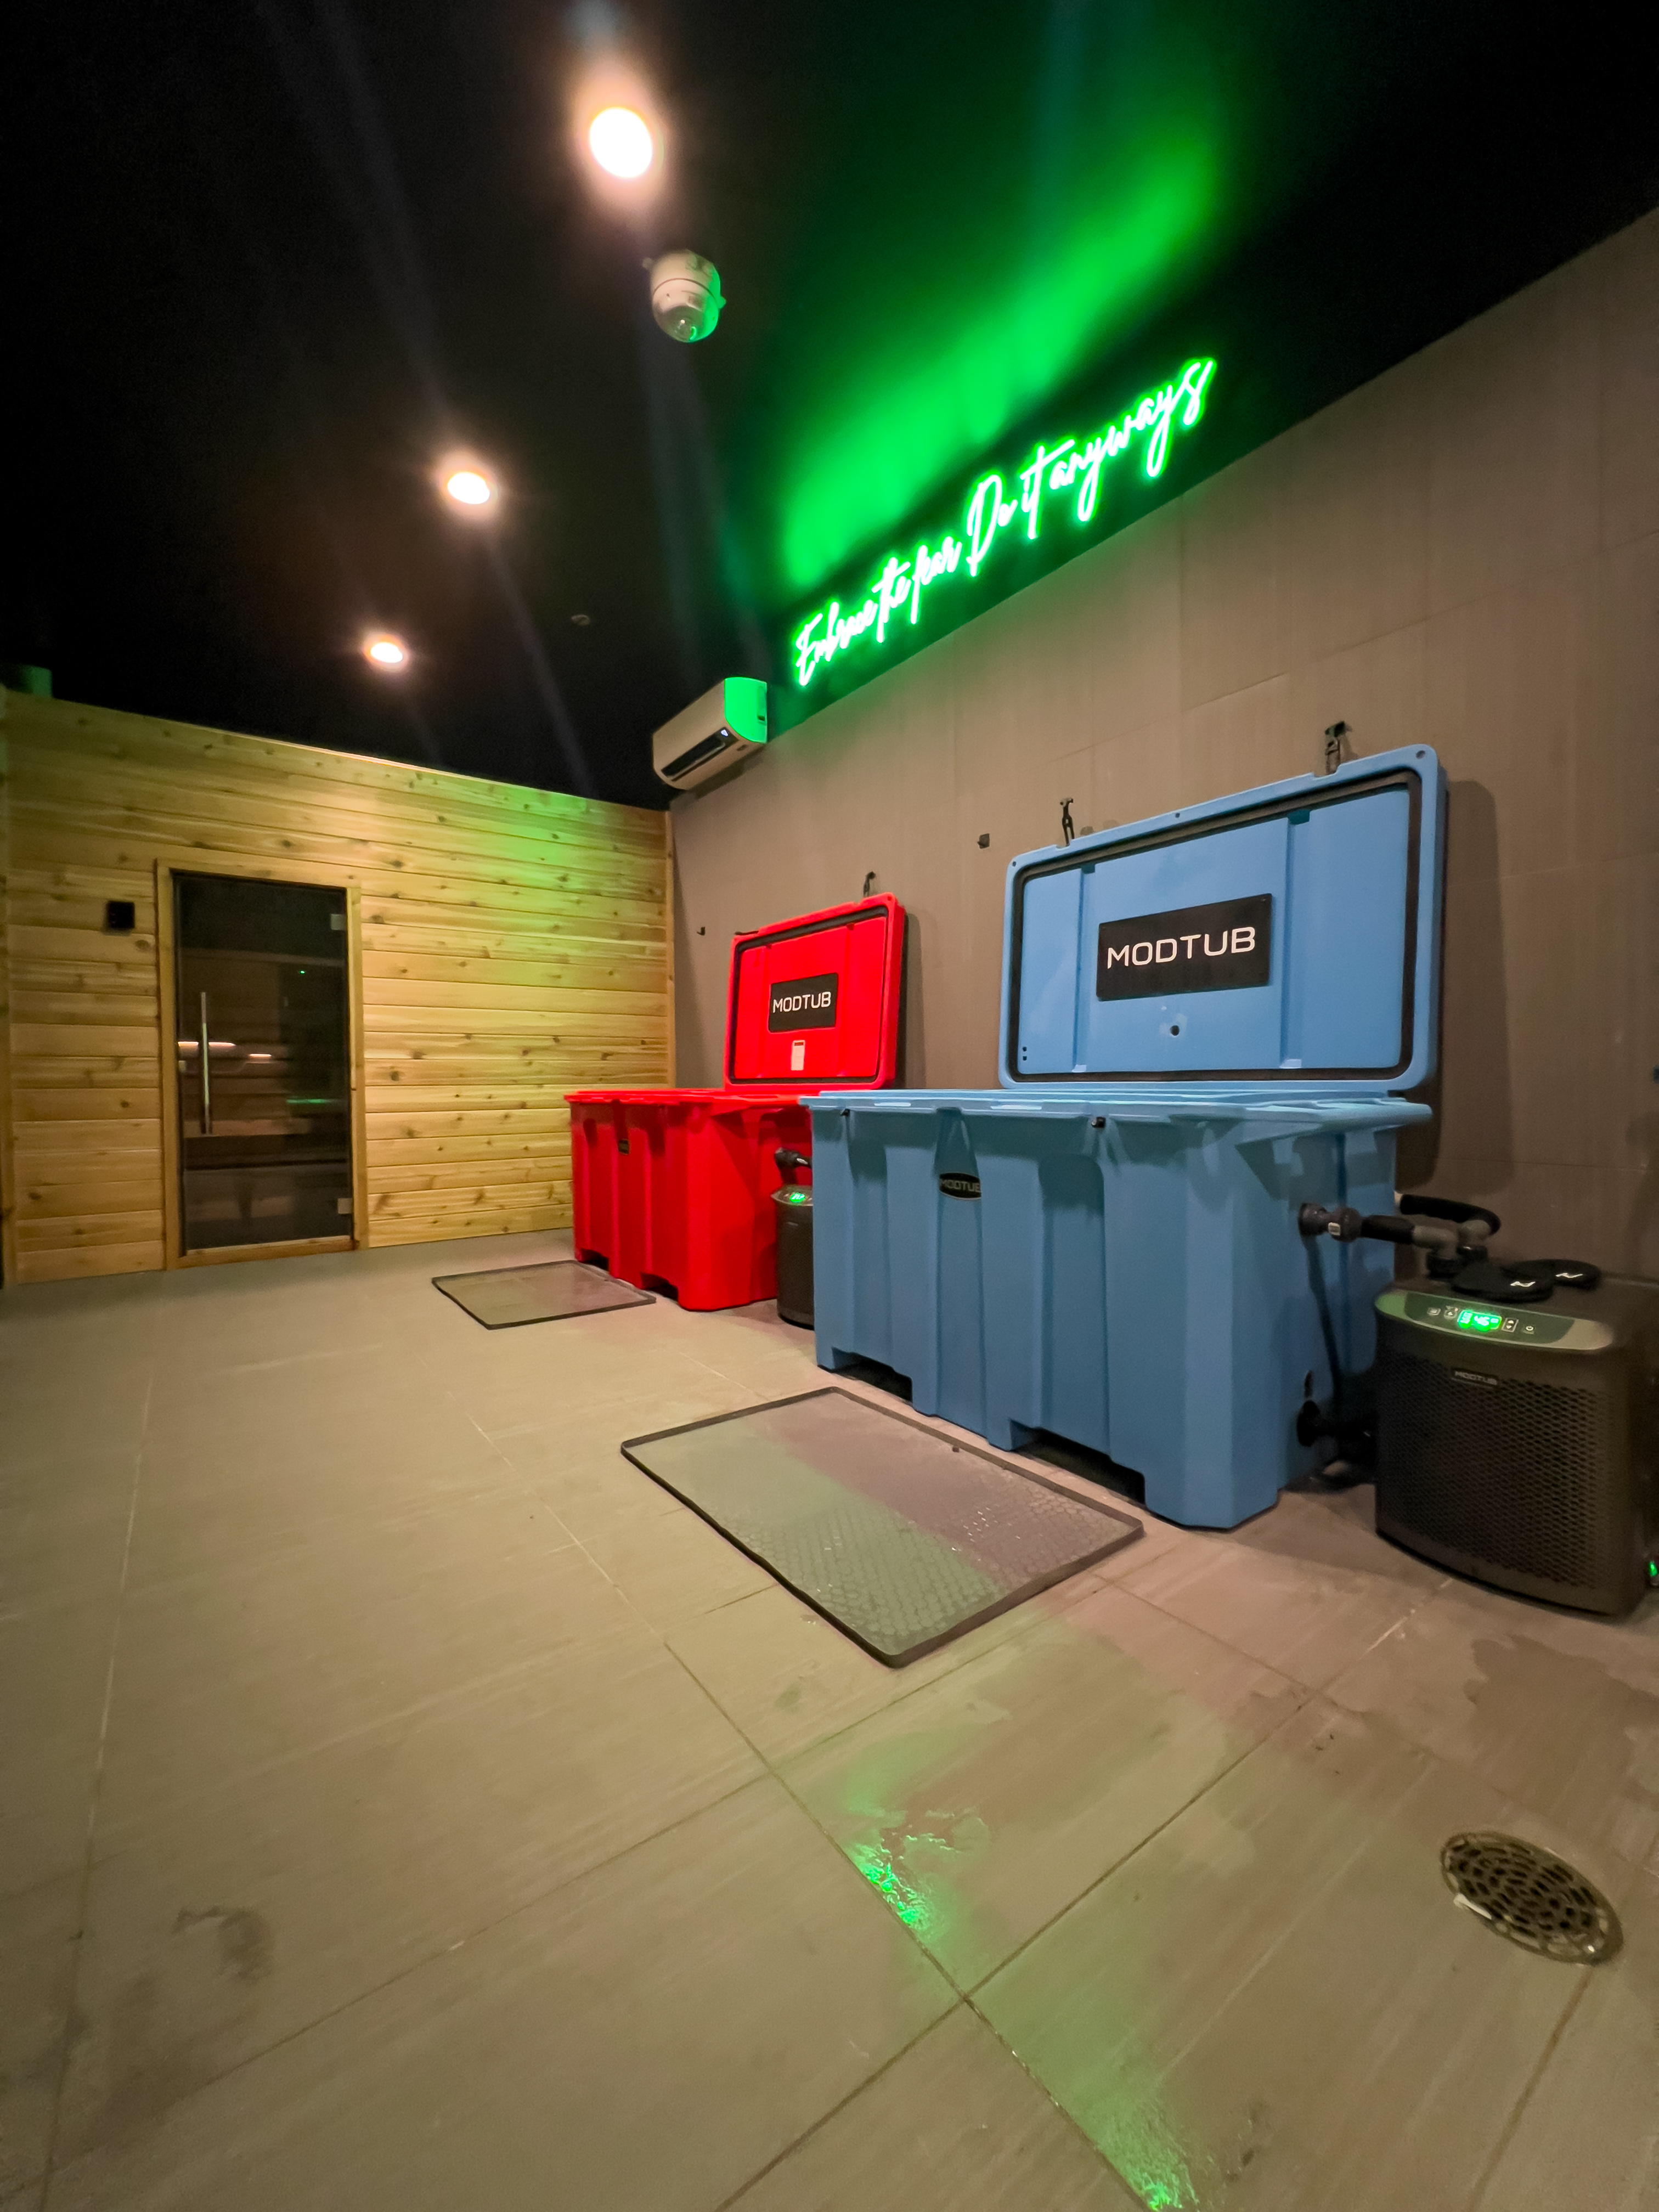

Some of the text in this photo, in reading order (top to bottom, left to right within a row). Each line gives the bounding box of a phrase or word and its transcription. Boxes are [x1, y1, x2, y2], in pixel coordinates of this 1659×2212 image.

[795, 359, 1215, 687] Embrace the fear Do it anyways
[1107, 926, 1256, 969] MODTUB
[772, 991, 831, 1013] MODTUB
